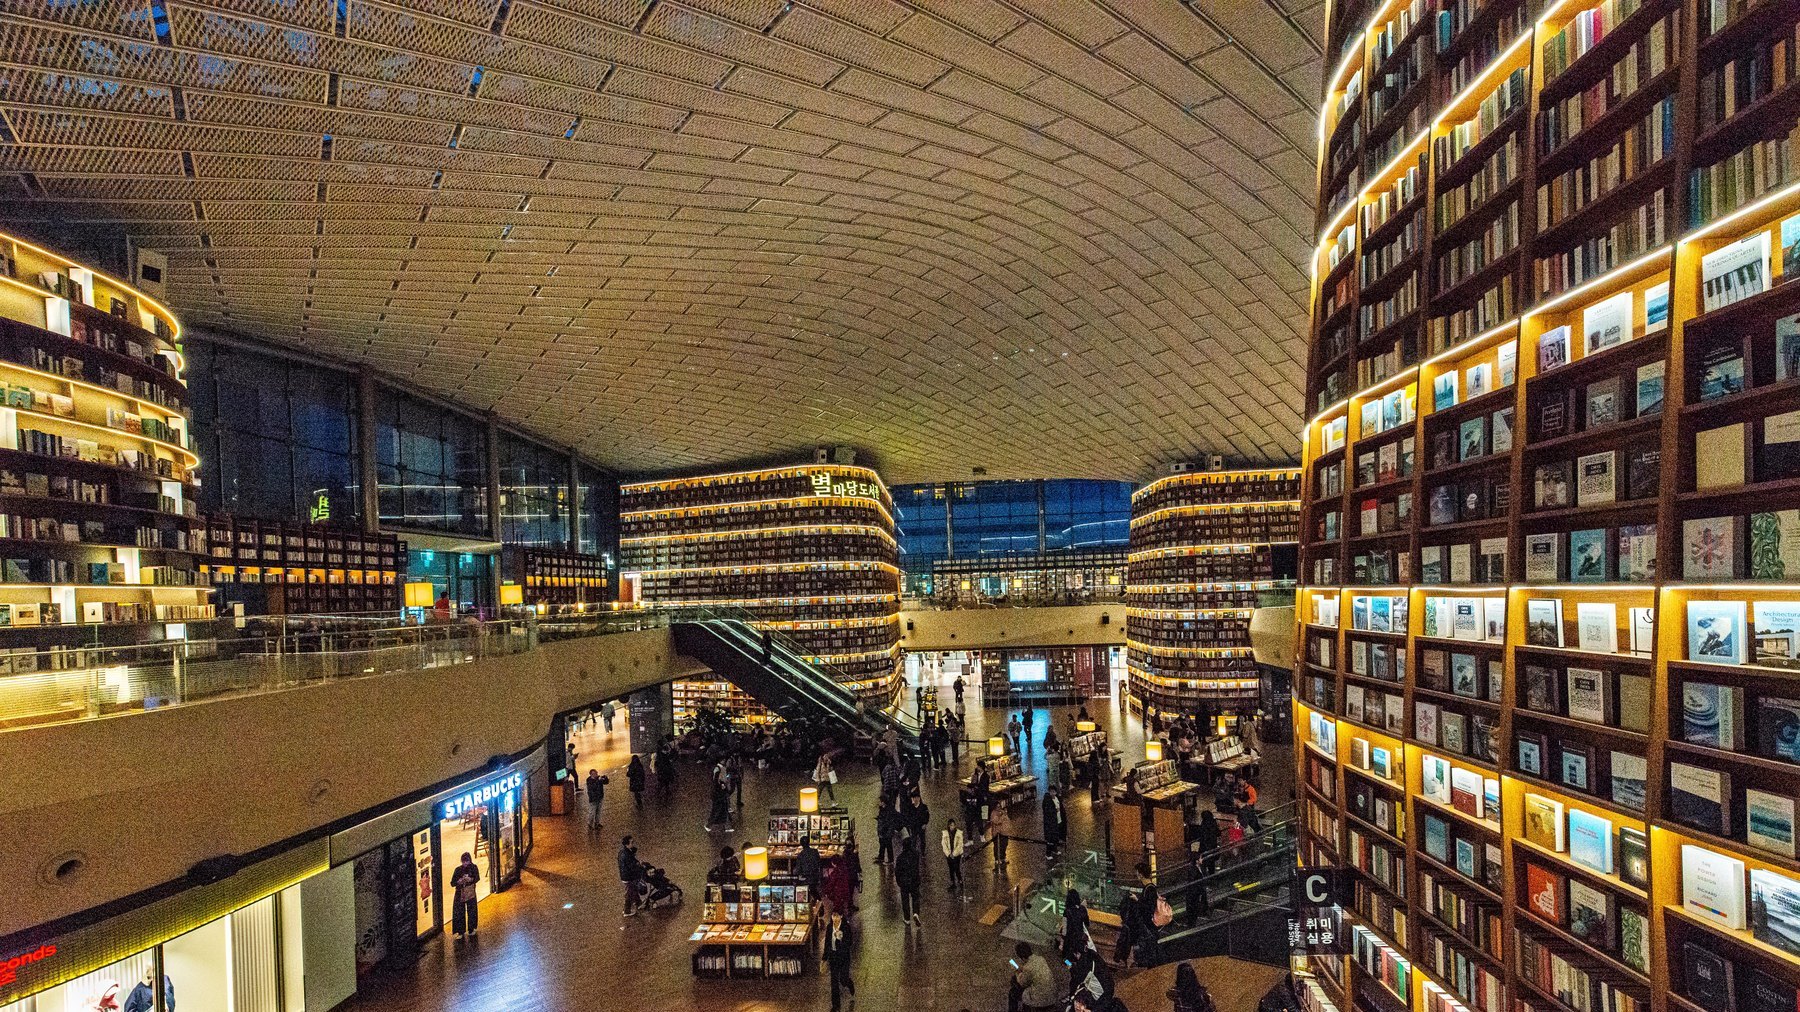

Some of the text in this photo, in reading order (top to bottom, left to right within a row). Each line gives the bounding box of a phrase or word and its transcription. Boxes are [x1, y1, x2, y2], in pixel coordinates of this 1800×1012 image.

[399, 542, 405, 551] E
[445, 773, 520, 818] STARBUCKS
[1306, 875, 1328, 902] C
[1306, 917, 1331, 930] 취미
[1306, 932, 1333, 945] 실용
